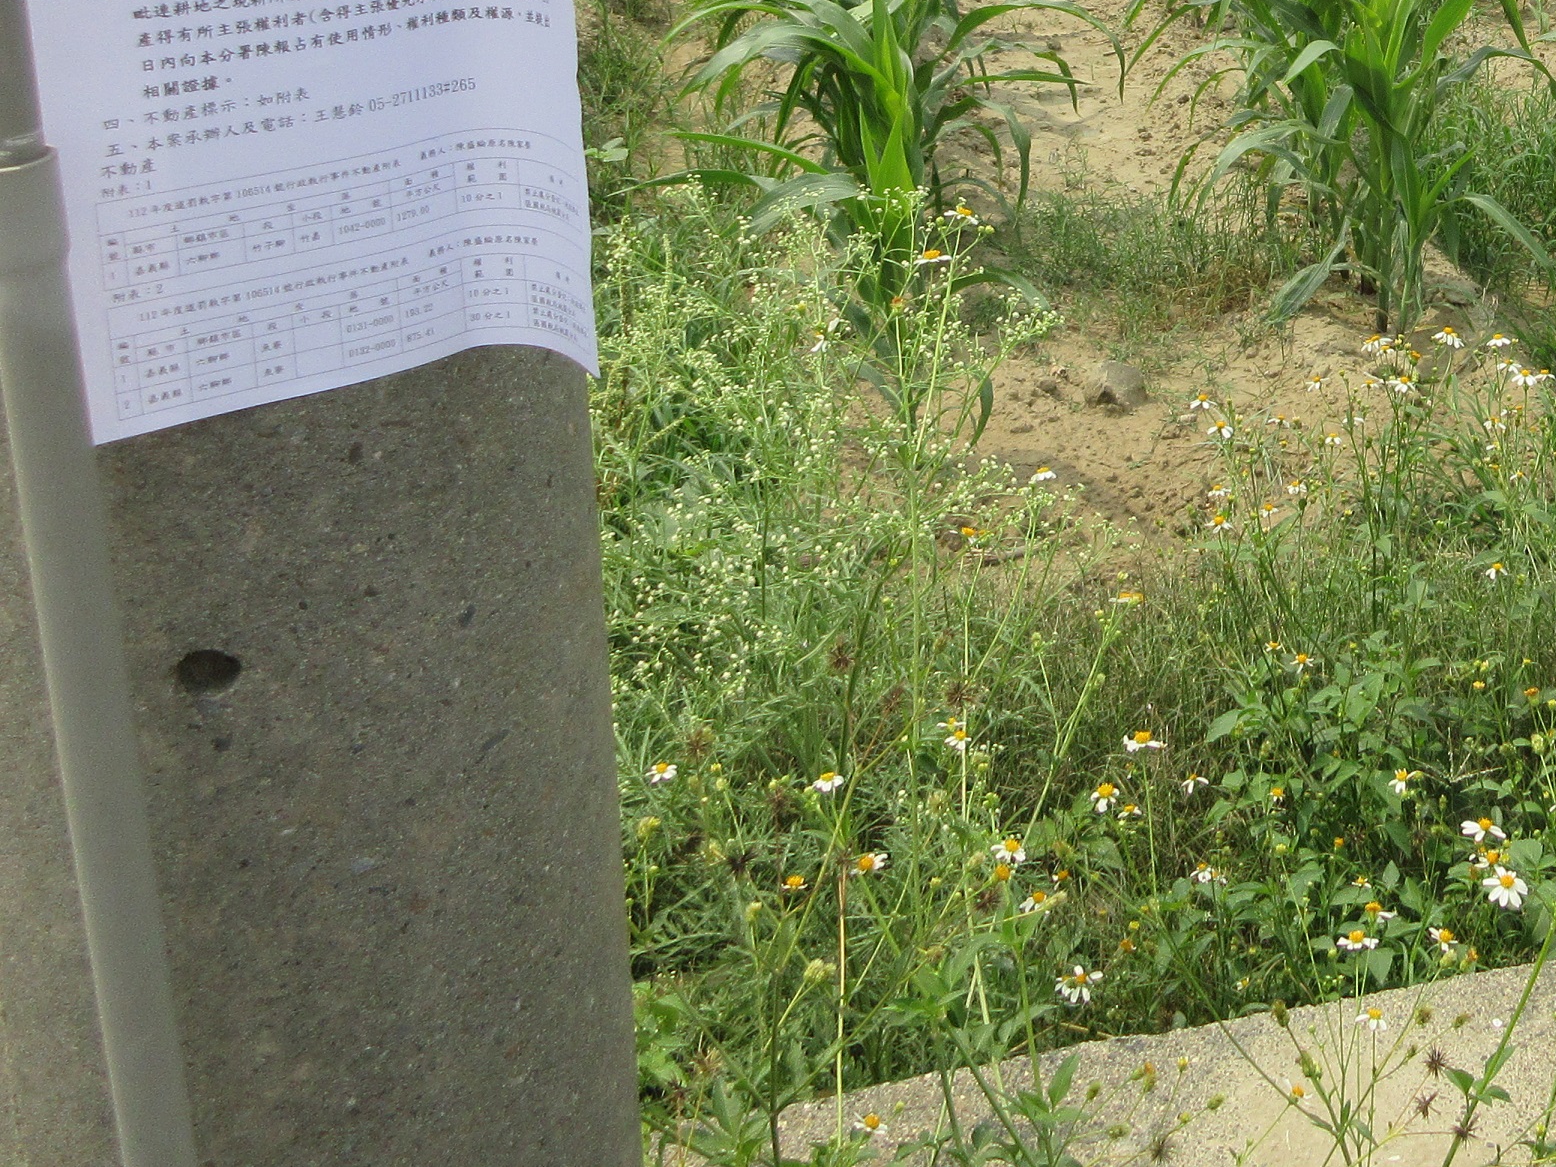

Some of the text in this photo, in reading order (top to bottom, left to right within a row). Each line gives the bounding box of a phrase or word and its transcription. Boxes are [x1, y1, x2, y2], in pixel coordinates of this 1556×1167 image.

[143, 74, 232, 100] 相關證據。
[101, 158, 157, 179] 不動產
